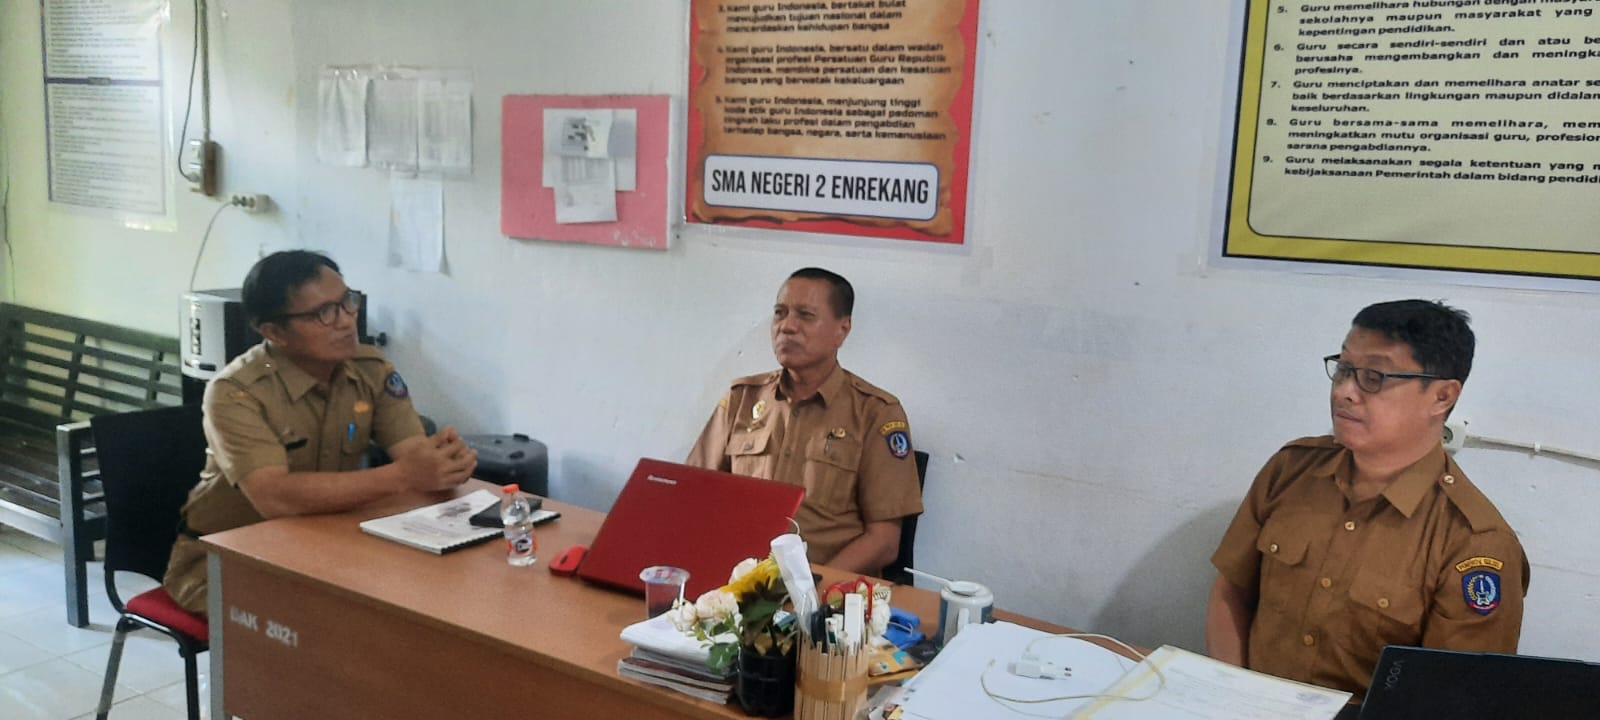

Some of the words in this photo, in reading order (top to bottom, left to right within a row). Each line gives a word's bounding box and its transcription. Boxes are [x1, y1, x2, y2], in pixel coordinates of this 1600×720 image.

[1300, 4, 1331, 12] Guru
[1333, 1, 1410, 11] memelihara
[1412, 0, 1482, 8] hubungan
[1299, 15, 1375, 25] sekolahnya
[1386, 13, 1442, 22] maupun
[1454, 9, 1542, 20] masyarakat
[1555, 8, 1593, 18] yang
[1298, 27, 1376, 37] kepentingan
[1378, 25, 1456, 35] pendidikan.
[1296, 43, 1327, 51] Guru
[1337, 42, 1379, 50] secara
[1390, 38, 1487, 49] sendiri-sendiri
[1499, 38, 1525, 46] dan
[1538, 37, 1571, 46] atau
[1296, 54, 1354, 63] berusaha
[1364, 51, 1481, 62] mengembangkan
[1492, 51, 1519, 59] dan
[1294, 66, 1363, 76] profesinya.
[1293, 80, 1323, 88] Guru
[1327, 80, 1410, 89] menciptakan
[1414, 79, 1439, 88] dan
[1444, 79, 1527, 88] memelihara
[1532, 79, 1580, 88] anatar
[1292, 92, 1318, 100] baik
[1322, 92, 1400, 100] berdasarkan
[1405, 91, 1480, 101] lingkungan
[1485, 92, 1542, 101] maupun
[1290, 104, 1370, 112] keseluruhan.
[1289, 118, 1322, 127] Guru
[1333, 118, 1439, 128] bersama-sama
[1451, 119, 1548, 130] memelihara,
[1288, 130, 1377, 140] meningkatkan
[1381, 131, 1415, 140] mutu
[1419, 132, 1489, 141] organisasi
[1494, 133, 1530, 142] guru,
[1329, 143, 1431, 153] pengabdiannya.
[1285, 155, 1315, 164] Guru
[1321, 157, 1412, 166] melaksanakan
[1419, 159, 1463, 169] segala
[1470, 160, 1542, 169] ketentuan
[1549, 162, 1585, 172] yang
[1284, 167, 1373, 178] kebijaksanaan
[1375, 170, 1451, 180] Pemerintah
[1453, 172, 1495, 181] dalam
[1498, 173, 1546, 184] bidang
[711, 169, 746, 194] SMA
[751, 171, 810, 197] NEGERI
[815, 174, 826, 198] 2
[831, 175, 929, 204] ENREKANG
